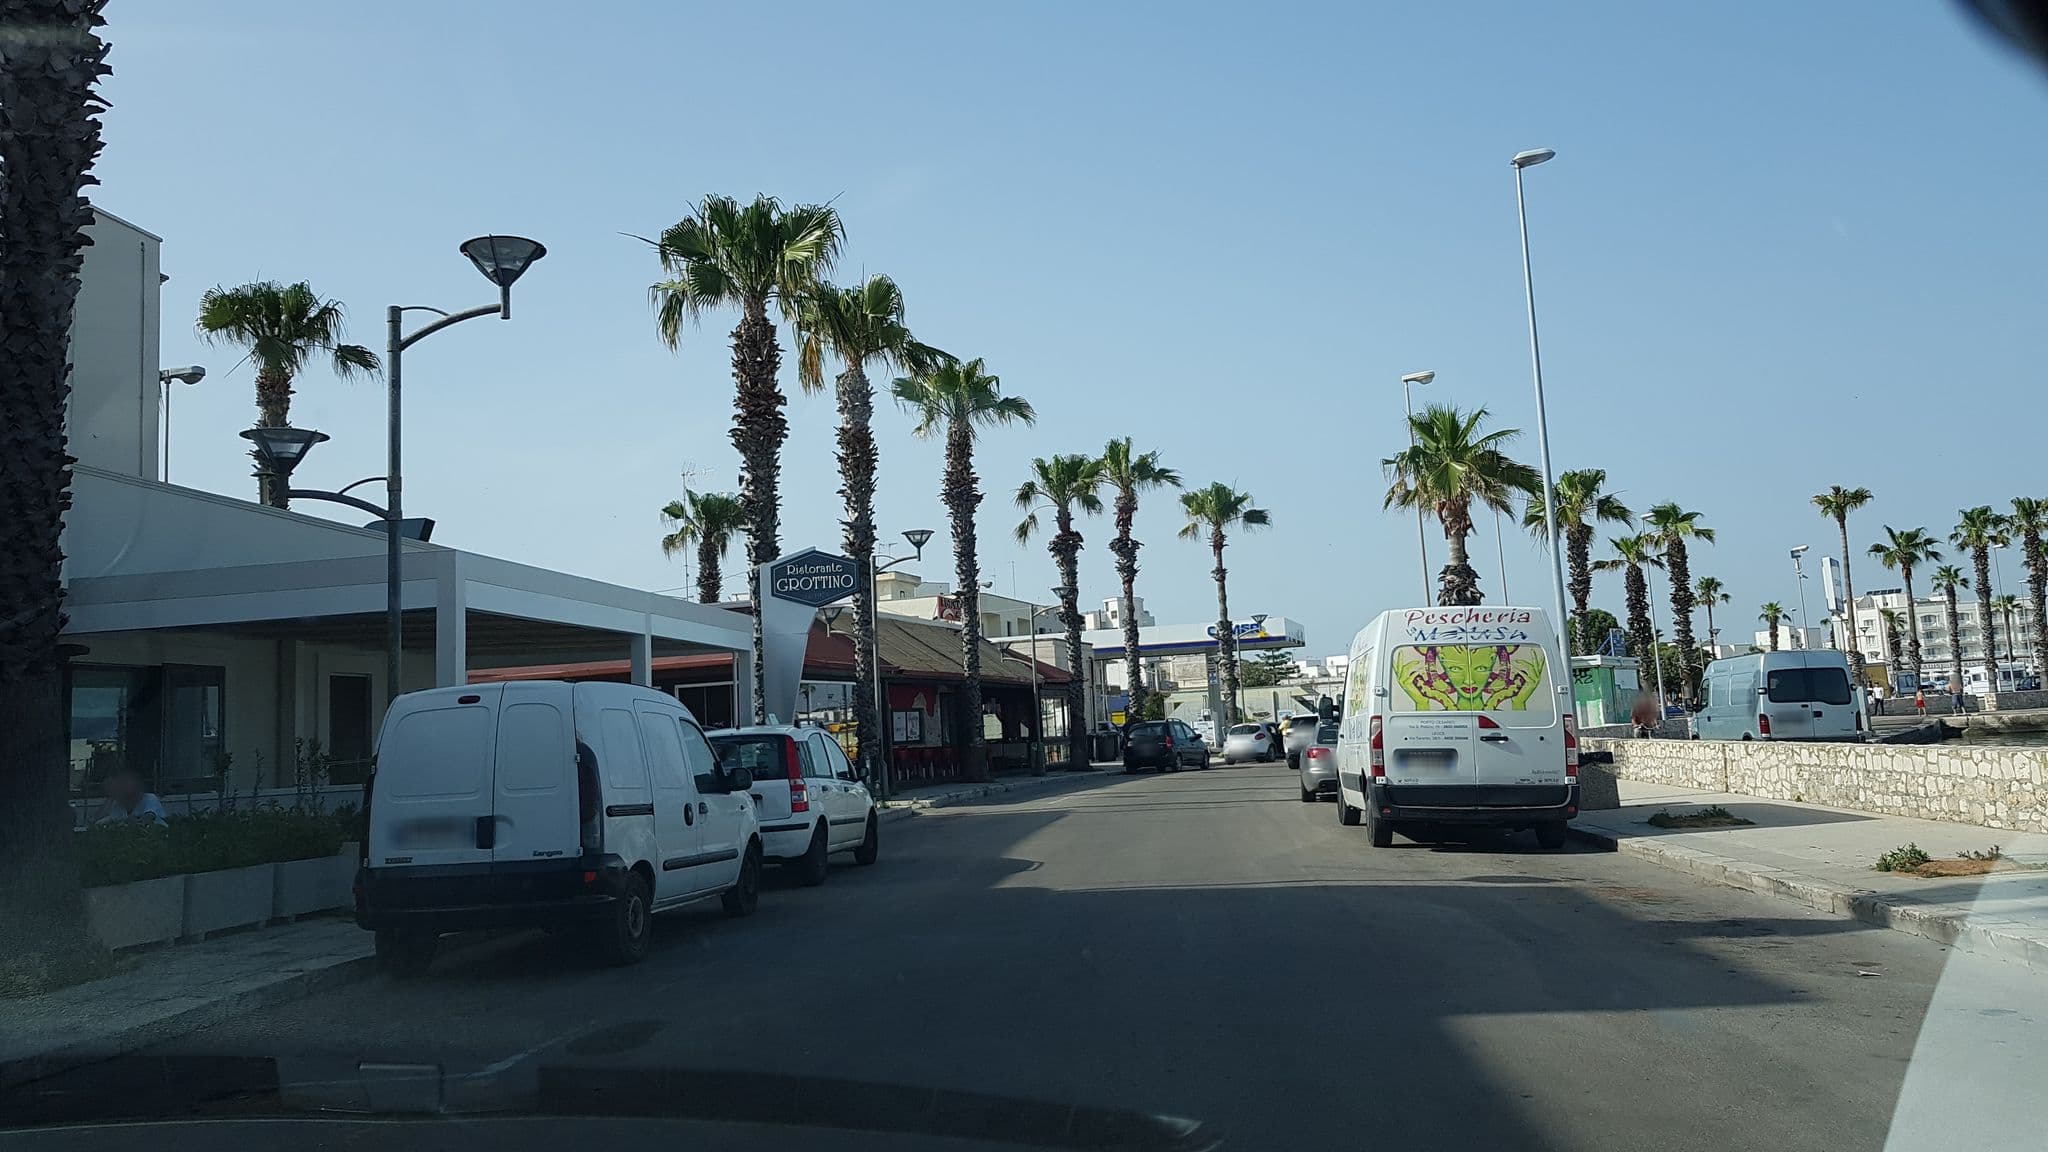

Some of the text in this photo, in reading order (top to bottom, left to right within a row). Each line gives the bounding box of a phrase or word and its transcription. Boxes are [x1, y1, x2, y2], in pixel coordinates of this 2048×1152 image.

[787, 563, 843, 575] Ristorante
[776, 574, 854, 592] GROTTINO
[1404, 607, 1530, 626] Pescheria
